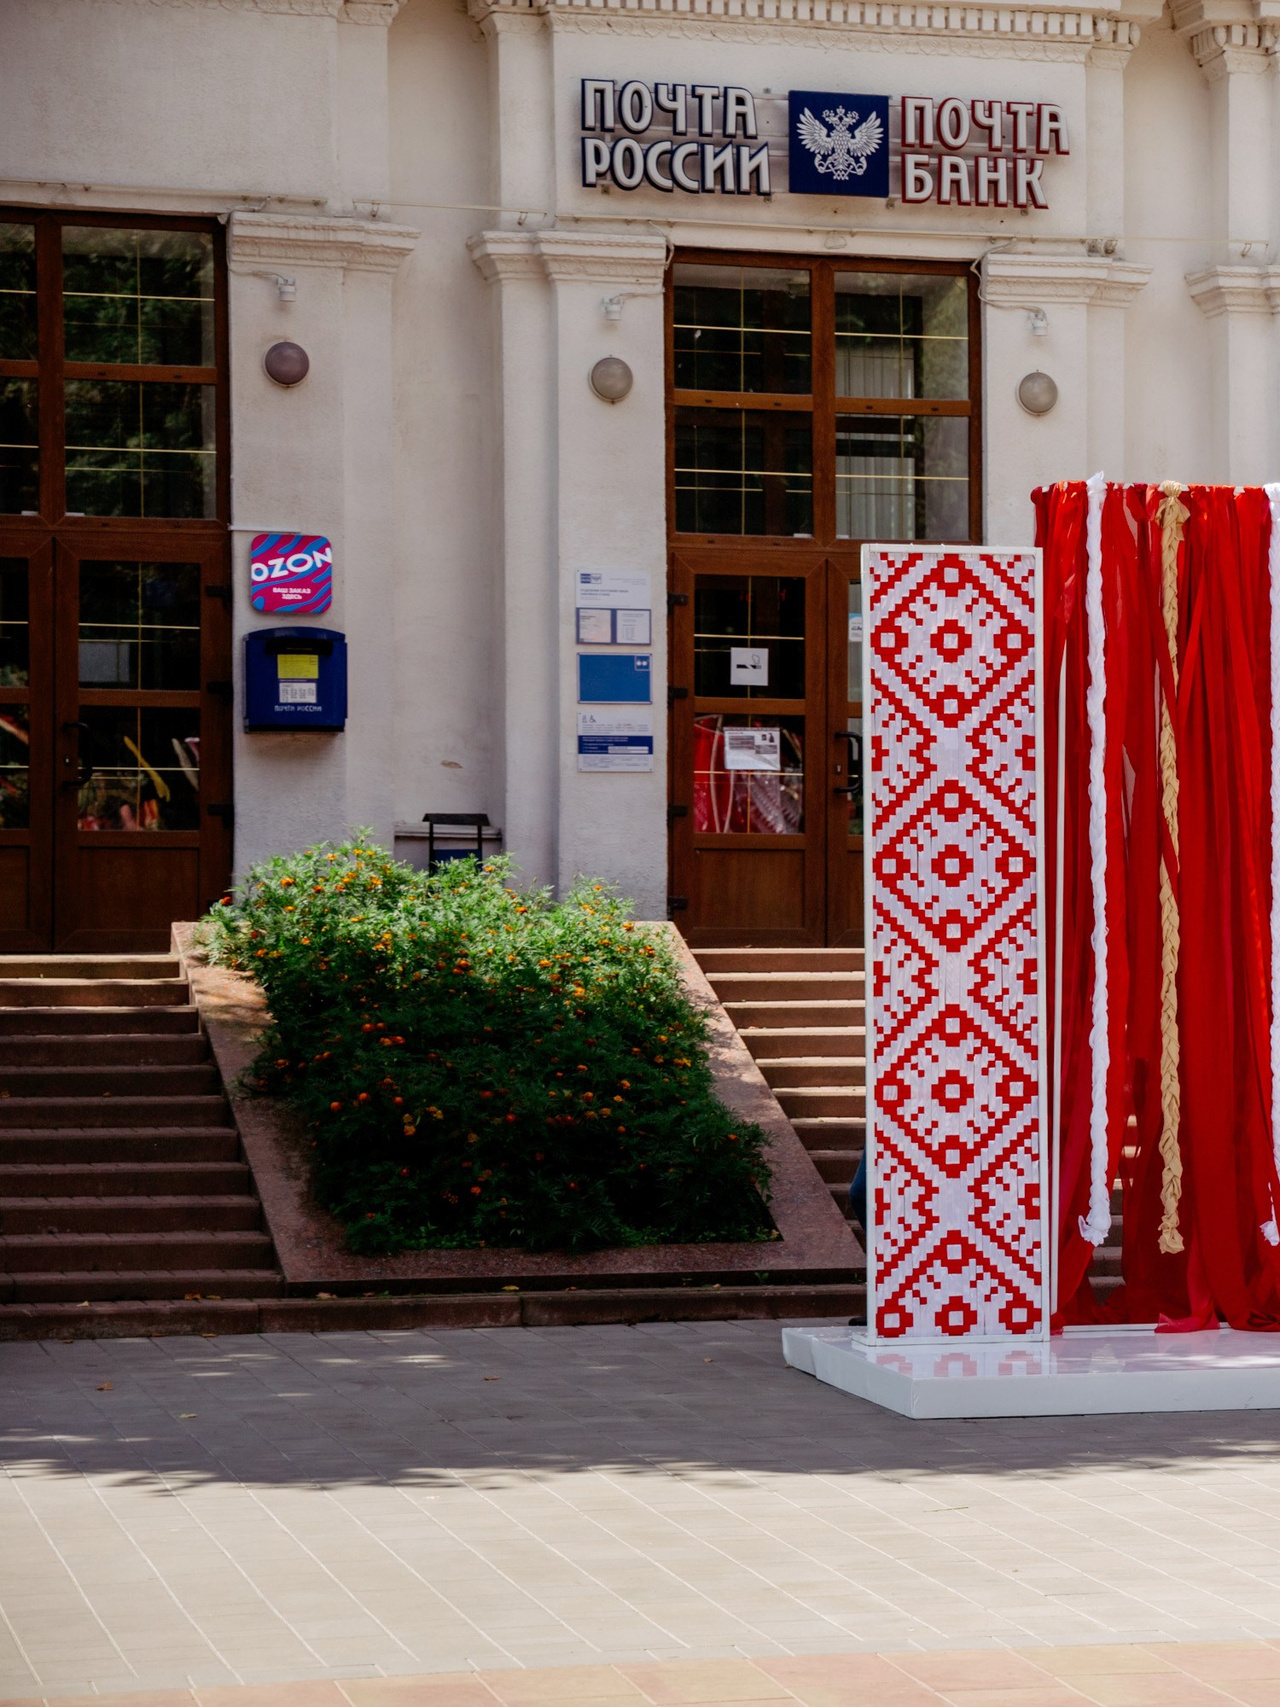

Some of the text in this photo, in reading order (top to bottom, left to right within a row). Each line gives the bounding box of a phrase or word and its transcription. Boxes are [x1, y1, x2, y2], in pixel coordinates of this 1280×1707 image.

[581, 78, 758, 139] ПОЧТА
[901, 96, 1070, 155] ПОЧТА
[581, 136, 772, 196] РОССИИ
[900, 152, 1049, 210] БАНК
[251, 547, 333, 582] OZON
